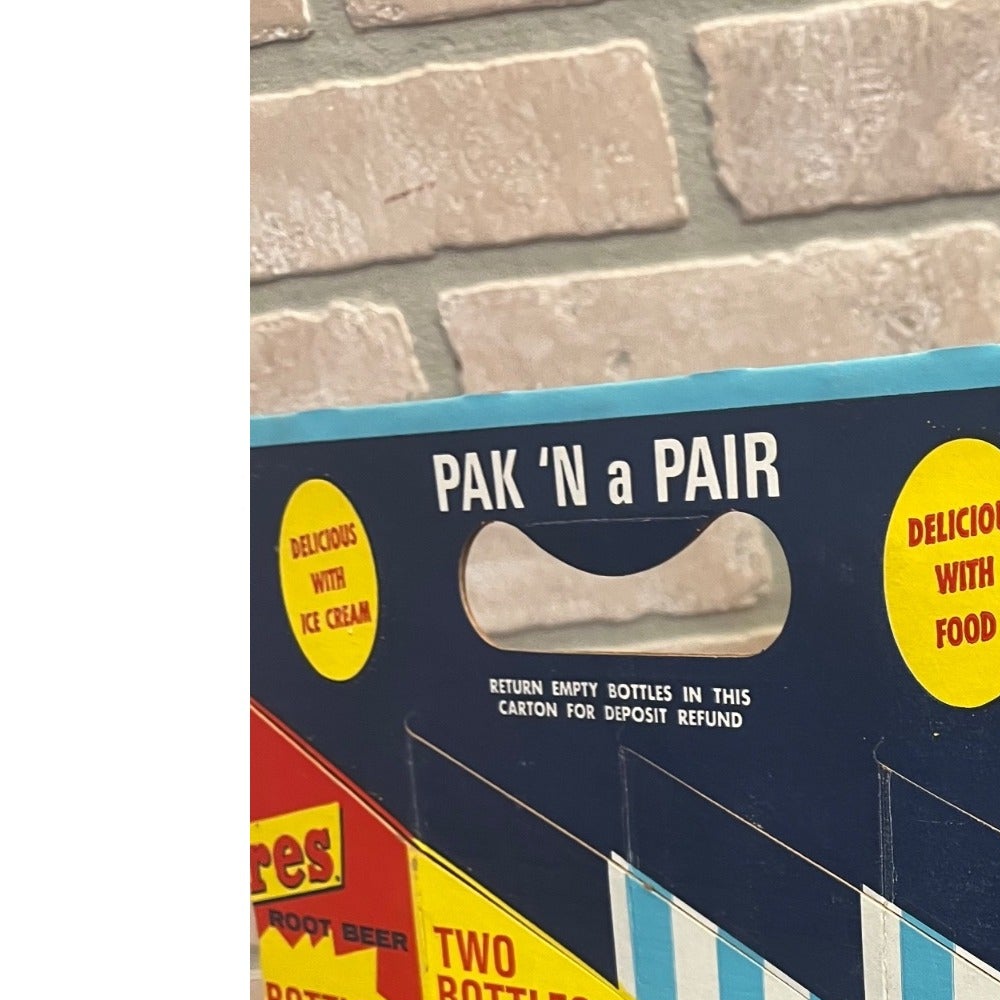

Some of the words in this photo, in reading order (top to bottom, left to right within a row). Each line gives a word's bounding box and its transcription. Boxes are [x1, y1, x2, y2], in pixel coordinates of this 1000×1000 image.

[433, 449, 525, 512] PAK
[608, 460, 634, 505] a
[654, 431, 782, 502] PAIR
[290, 522, 358, 559] DELICIOUS
[310, 566, 347, 595] WITH
[934, 555, 995, 595] WITH
[300, 611, 322, 635] ICE
[325, 600, 373, 630] CREAM
[935, 611, 997, 649] FOOD
[489, 678, 544, 696] RETURN
[551, 680, 598, 698] EMPTY
[608, 683, 673, 702] BOTTLES
[682, 686, 702, 703] IN
[713, 687, 752, 706] THIS
[498, 699, 559, 718] CARTON
[566, 703, 596, 720] FOR
[604, 705, 668, 724] DEPOSIT
[678, 709, 743, 728] REFUND
[249, 827, 336, 895] res
[268, 908, 332, 938] ROOT
[341, 922, 409, 952] BEER
[433, 926, 517, 979] TWO
